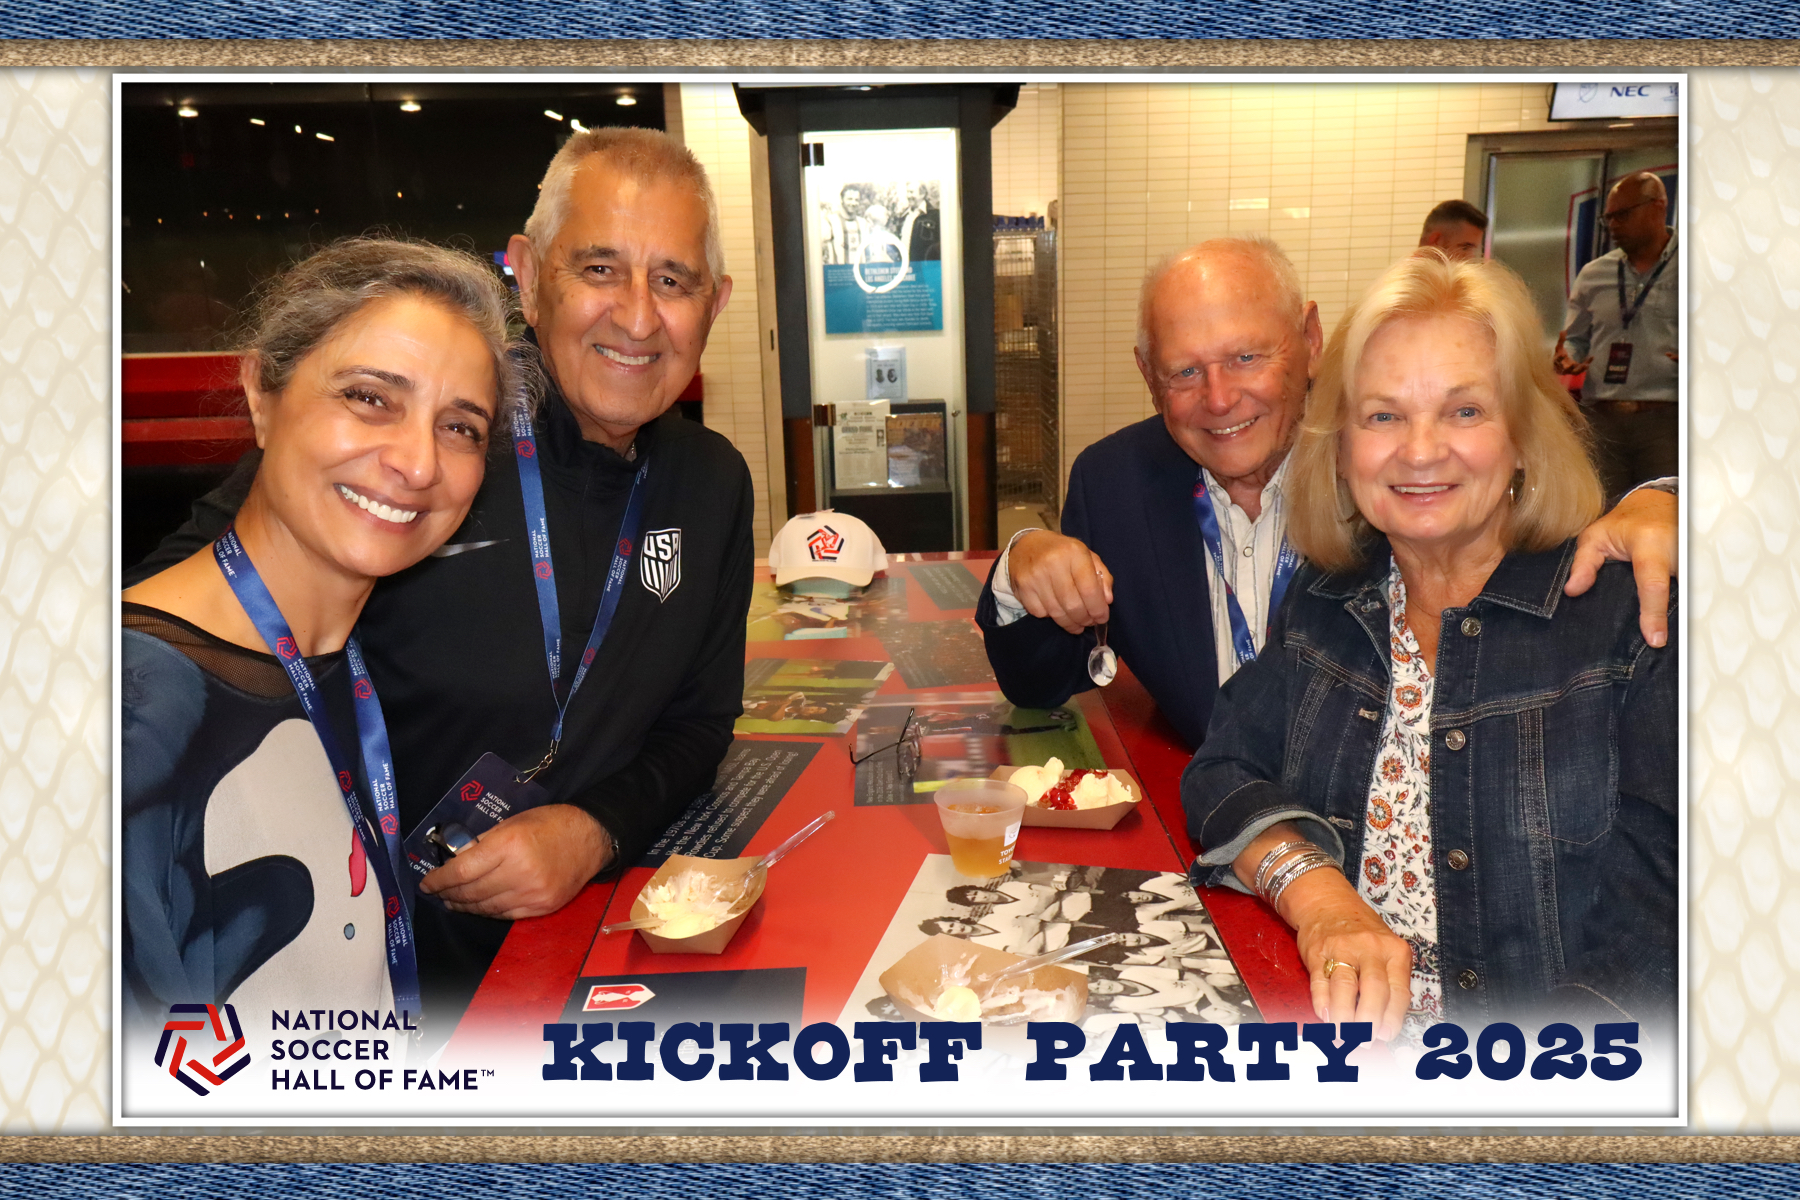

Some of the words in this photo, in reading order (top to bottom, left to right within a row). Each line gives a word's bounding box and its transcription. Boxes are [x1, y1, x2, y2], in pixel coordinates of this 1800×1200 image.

[1610, 84, 1651, 97] NEC
[512, 410, 521, 437] NATIONAL
[518, 413, 527, 437] SOCCER
[227, 531, 242, 557] NATIONAL
[531, 529, 540, 559] NATIONAL
[537, 534, 545, 558] SOCCER
[542, 533, 548, 542] OF
[644, 533, 679, 561] USA
[611, 569, 616, 578] OF
[615, 557, 624, 579] SOCCER
[617, 559, 628, 585] NATIONAL
[288, 663, 300, 682] HALL
[298, 682, 306, 691] OF
[293, 661, 309, 688] SOCCER
[298, 658, 316, 691] NATIONAL
[744, 758, 761, 767] Bay
[731, 767, 752, 781] Tampa
[372, 778, 384, 812] NATIONAL
[386, 781, 393, 791] OF
[725, 781, 738, 791] and
[380, 783, 390, 811] SOCCER
[388, 791, 396, 809] HALL
[480, 797, 503, 813] SOCCER
[485, 791, 512, 812] NATIONAL
[684, 834, 712, 857] Rowdies
[707, 814, 729, 834] refused
[729, 787, 752, 807] compete
[751, 771, 764, 779] the
[765, 750, 782, 760] Open
[705, 791, 730, 809] Cosmos
[475, 803, 488, 815] HALL
[489, 811, 498, 819] OF
[695, 811, 713, 821] York
[703, 845, 723, 858] Cup.
[715, 828, 736, 844] Some
[731, 807, 753, 827] suspect
[745, 796, 763, 807] they
[756, 784, 771, 795] were
[765, 770, 782, 784] afraid
[663, 820, 687, 837] 1970s
[683, 823, 702, 835] New
[675, 835, 692, 845] the
[419, 859, 435, 870] NATIO
[420, 868, 428, 876] FA
[392, 919, 401, 945] SOCCER
[398, 915, 409, 947] NATIONAL
[389, 939, 395, 949] OF
